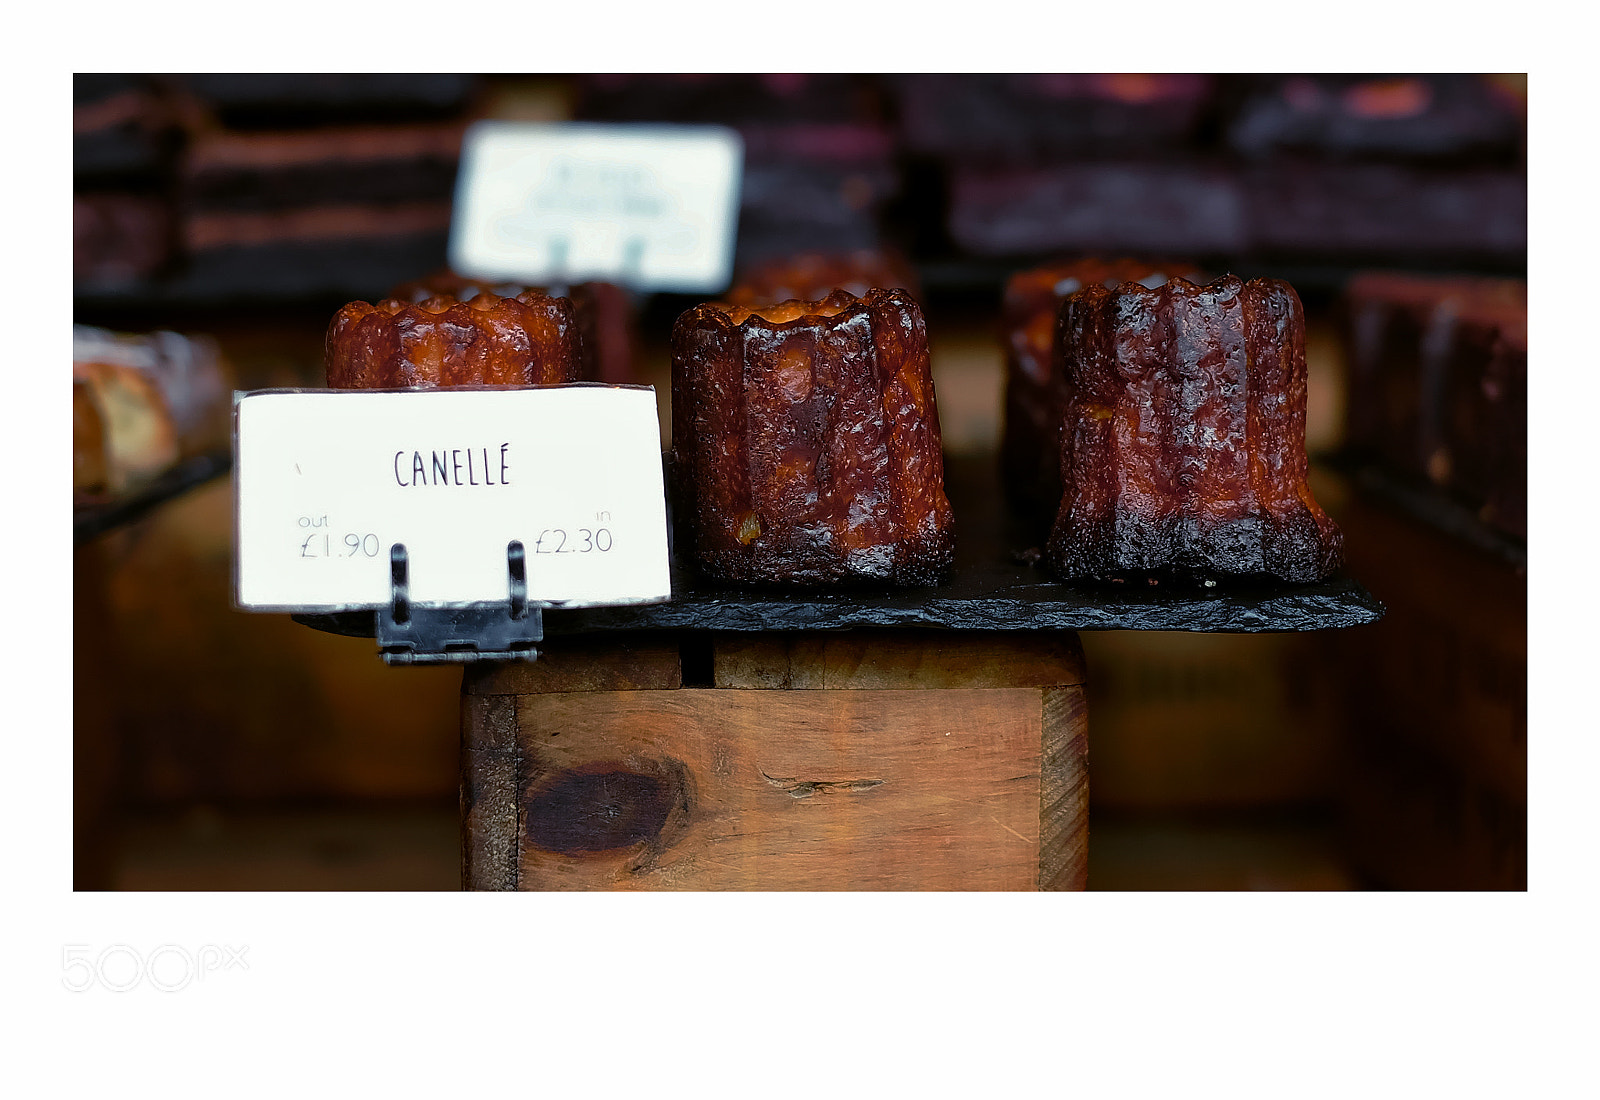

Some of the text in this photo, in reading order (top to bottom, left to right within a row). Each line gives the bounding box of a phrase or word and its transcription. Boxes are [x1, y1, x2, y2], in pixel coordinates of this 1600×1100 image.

[394, 442, 510, 487] CANELLÉ
[298, 514, 329, 528] out
[595, 510, 612, 522] in
[300, 533, 380, 558] £1.90
[535, 528, 613, 554] £2.30
